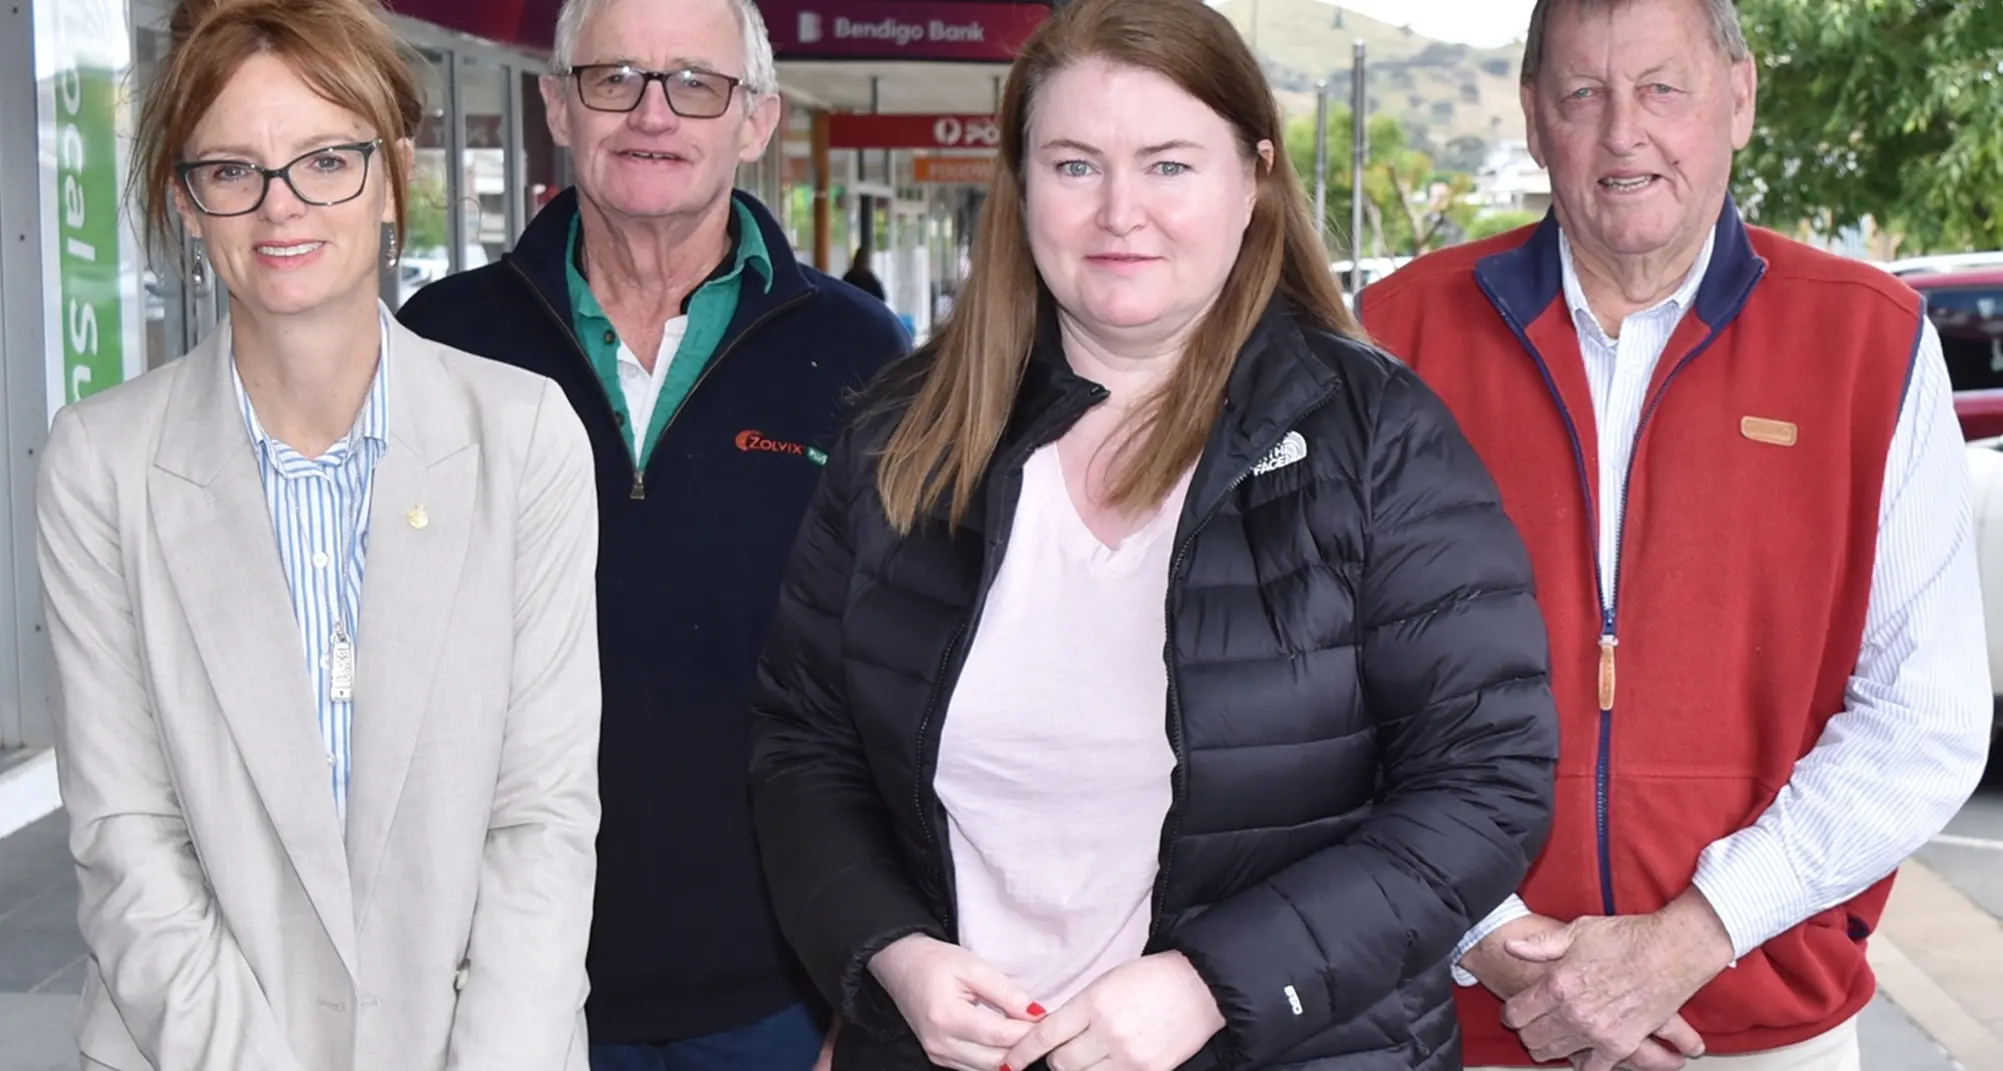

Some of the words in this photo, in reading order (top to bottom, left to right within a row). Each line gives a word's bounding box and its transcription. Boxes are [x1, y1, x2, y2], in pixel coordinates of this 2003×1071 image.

[833, 16, 924, 45] Bendigo
[928, 19, 985, 42] Bank
[749, 435, 803, 455] ZOLVIX
